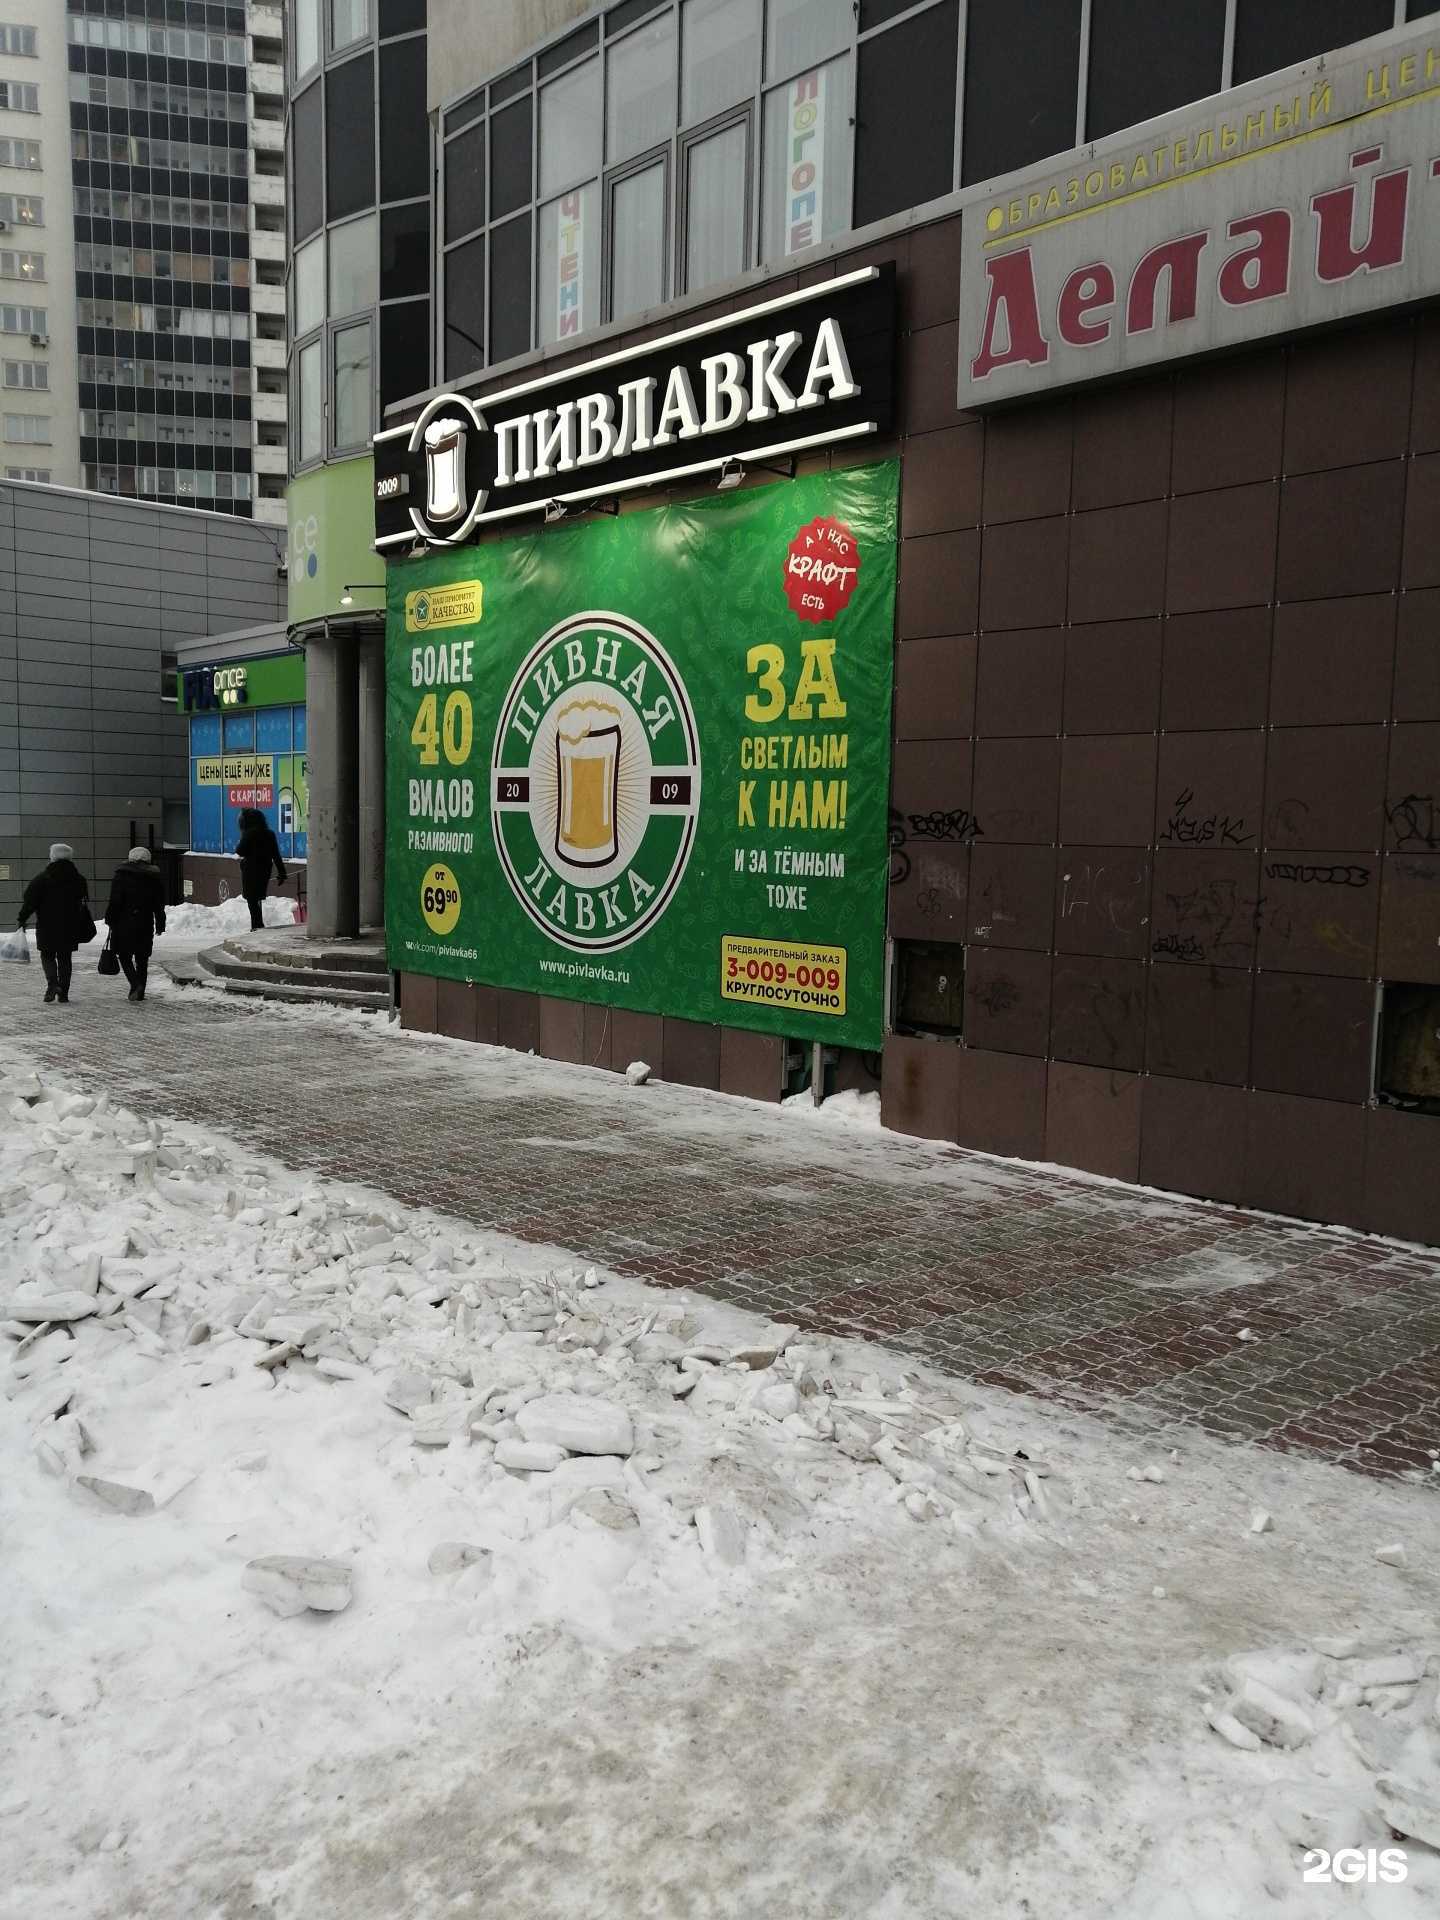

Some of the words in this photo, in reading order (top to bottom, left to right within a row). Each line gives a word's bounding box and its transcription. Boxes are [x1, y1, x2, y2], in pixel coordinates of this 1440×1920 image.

[494, 317, 861, 488] ПИВЛАВКА
[377, 477, 398, 496] 2009
[806, 535, 814, 548] А
[817, 528, 824, 540] У
[828, 529, 848, 555] НАС
[789, 553, 856, 591] КРАФТ
[433, 602, 475, 618] КАЧЕСТВО
[801, 594, 825, 609] ЕСТЬ
[411, 641, 474, 687] БОЛЕЕ
[213, 667, 246, 695] price
[512, 637, 675, 744] ПИВНАЯ
[745, 639, 847, 723] ЗА
[411, 690, 473, 765] 40
[741, 735, 848, 770] СВЕТЛЫМ
[200, 765, 222, 781] ЦЕНЫ
[224, 761, 241, 780] ЕЩЁ
[244, 764, 271, 778] НИЖЕ
[230, 790, 236, 802] С
[237, 788, 271, 803] КАРТОЙ!
[409, 779, 474, 824] ВИДОВ
[738, 780, 756, 828] К
[768, 780, 848, 830] НАМ!
[408, 830, 473, 853] РАЗЛИВНОГО!
[735, 849, 744, 872] И
[749, 849, 767, 874] ЗА
[774, 846, 845, 878] ТЁМНЫМ
[524, 858, 655, 930] ЛАВКА
[767, 885, 807, 910] ТОЖЕ
[727, 944, 808, 961] ПРЕДВАРИТЕЛЬНЫЙ
[811, 953, 840, 965] ЗАКАЗ
[539, 959, 630, 984] www.pivlavka.ru
[727, 957, 840, 990] 3-009-009
[726, 981, 840, 1008] КРУГЛОСУТОЧНО
